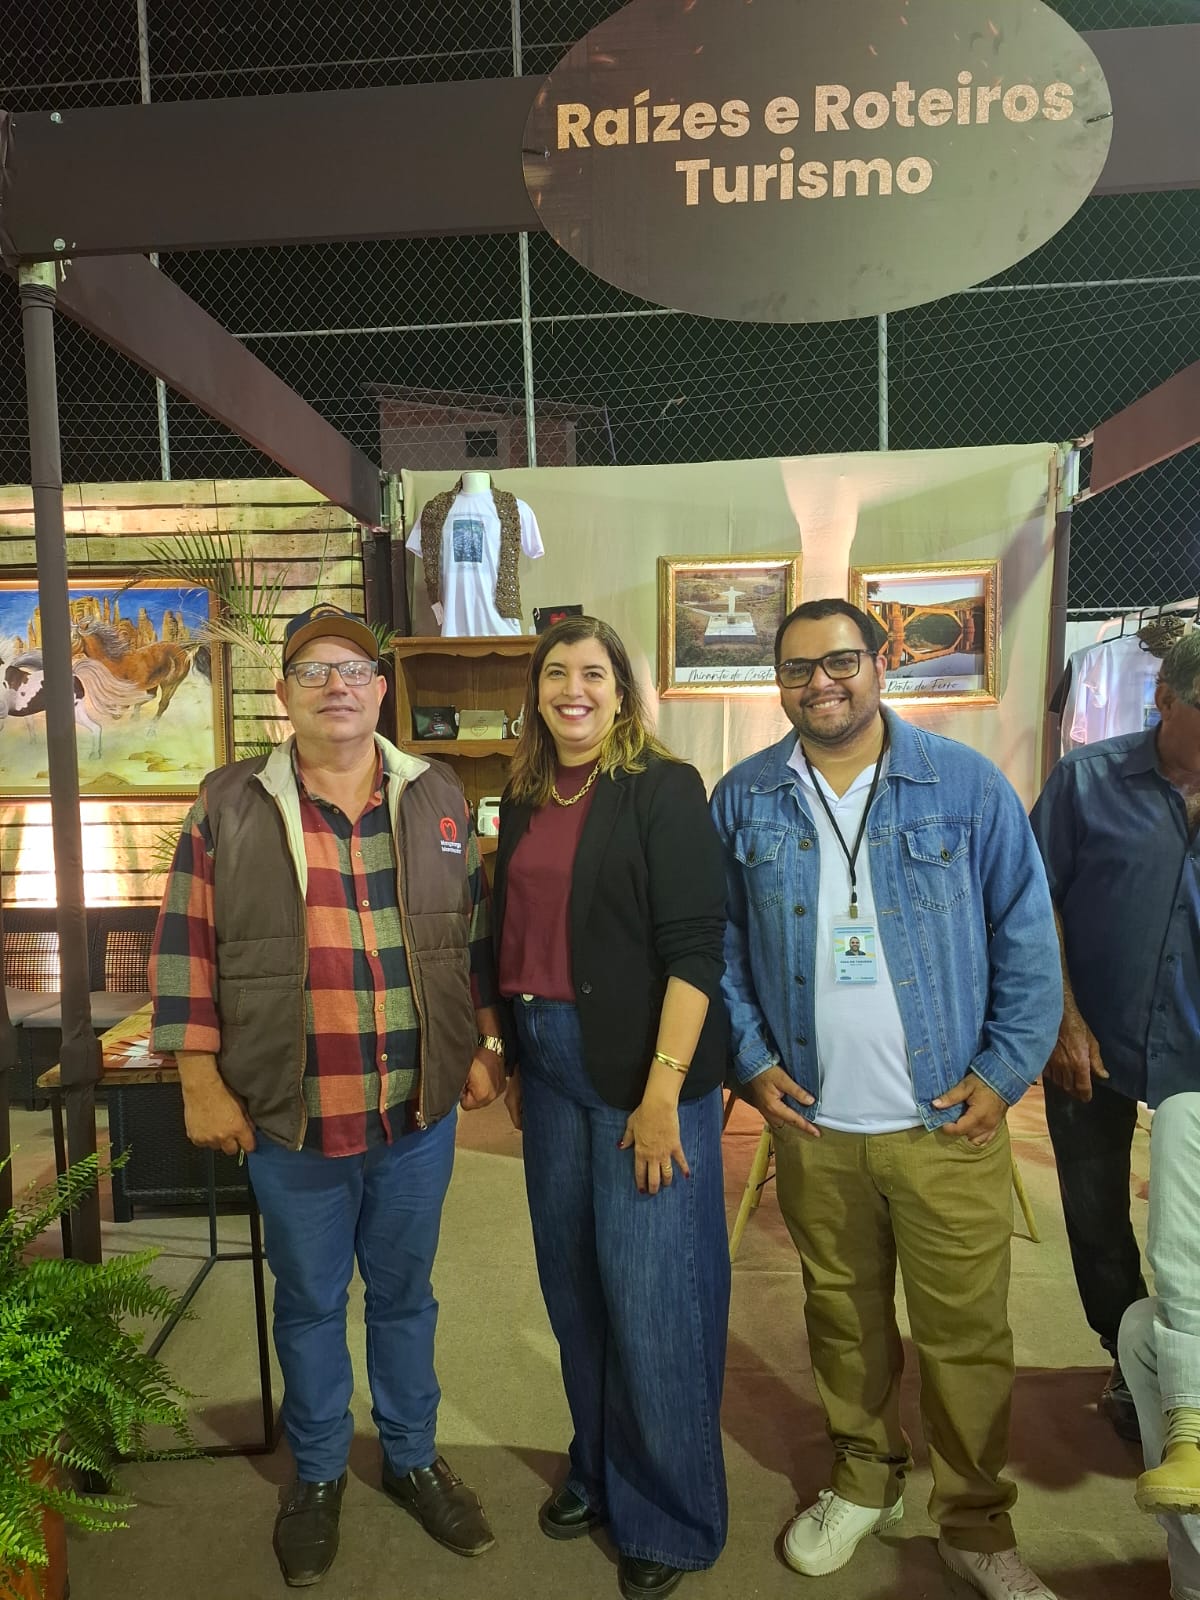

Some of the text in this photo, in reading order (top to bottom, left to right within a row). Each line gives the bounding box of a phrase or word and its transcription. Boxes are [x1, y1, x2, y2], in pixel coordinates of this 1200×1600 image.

[556, 70, 1075, 150] Raízes e Roteiros
[675, 147, 934, 206] Turismo
